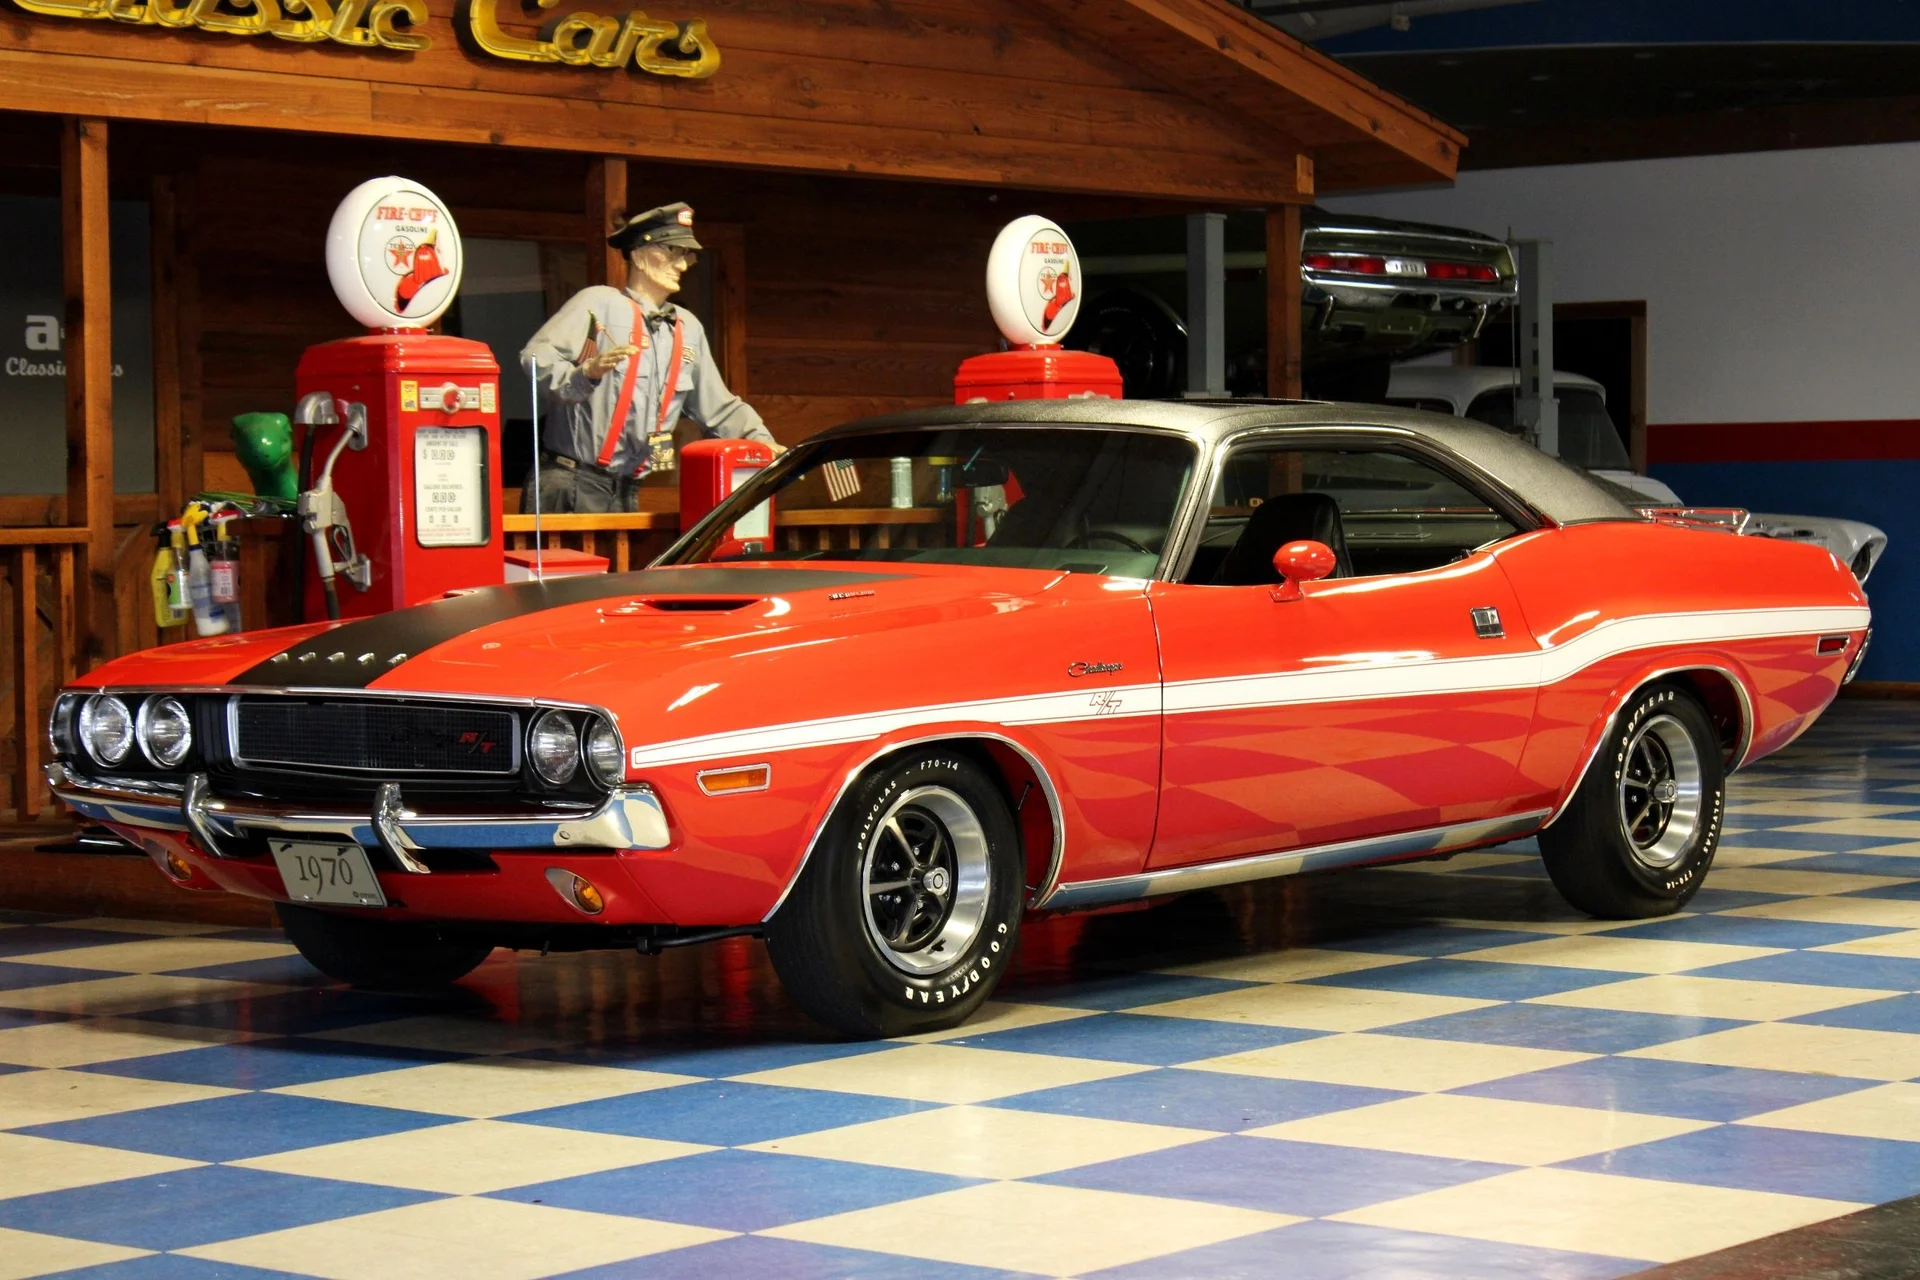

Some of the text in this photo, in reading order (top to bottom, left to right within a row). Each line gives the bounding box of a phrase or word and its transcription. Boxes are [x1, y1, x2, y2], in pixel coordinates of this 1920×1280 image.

[469, 0, 720, 78] Cars
[1089, 691, 1123, 716] R/T
[1614, 691, 1675, 780] GOODYEAR
[458, 730, 497, 754] R/T
[857, 780, 897, 851] POLYGLAS
[920, 759, 959, 771] F70-14
[1702, 790, 1721, 854] POLYGLAS
[295, 855, 353, 896] 1970
[905, 922, 1008, 1004] GOODYEAR
